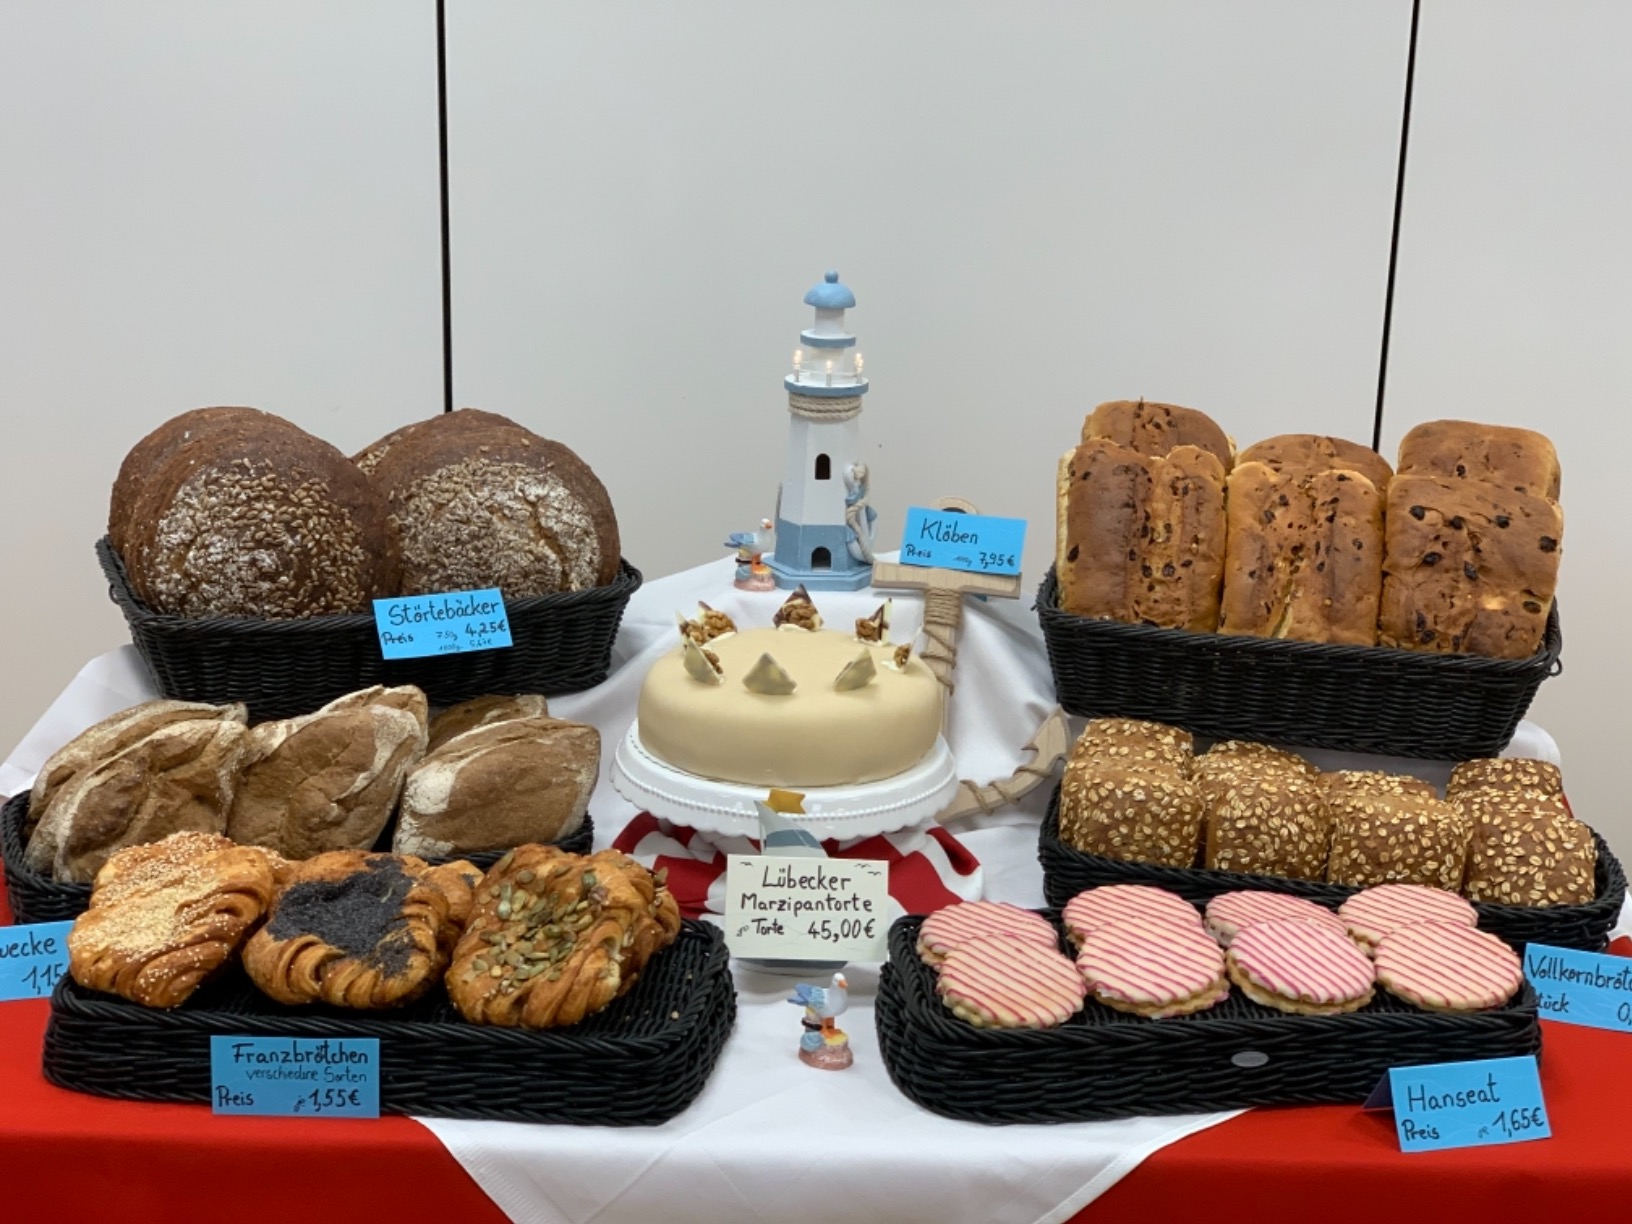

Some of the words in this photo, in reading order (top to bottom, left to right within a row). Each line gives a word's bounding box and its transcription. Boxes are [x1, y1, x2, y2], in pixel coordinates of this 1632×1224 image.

[920, 518, 978, 544] Klöben
[905, 543, 932, 558] Preis
[388, 595, 500, 626] Störtebäcker
[381, 631, 414, 645] Preis
[465, 619, 507, 637] 4,25€
[762, 864, 851, 890] Lübecker
[740, 892, 873, 917] Marzipantorte
[751, 918, 785, 936] Torte
[807, 918, 876, 943] 45,00€
[232, 1040, 369, 1065] Franzbrötchen
[324, 1066, 367, 1083] Sorten
[216, 1085, 254, 1108] Preis
[308, 1088, 362, 1112] 1,55€
[1407, 1072, 1501, 1112] Hanseat
[1401, 1119, 1440, 1142] Preis
[1492, 1107, 1545, 1138] 1,65€
